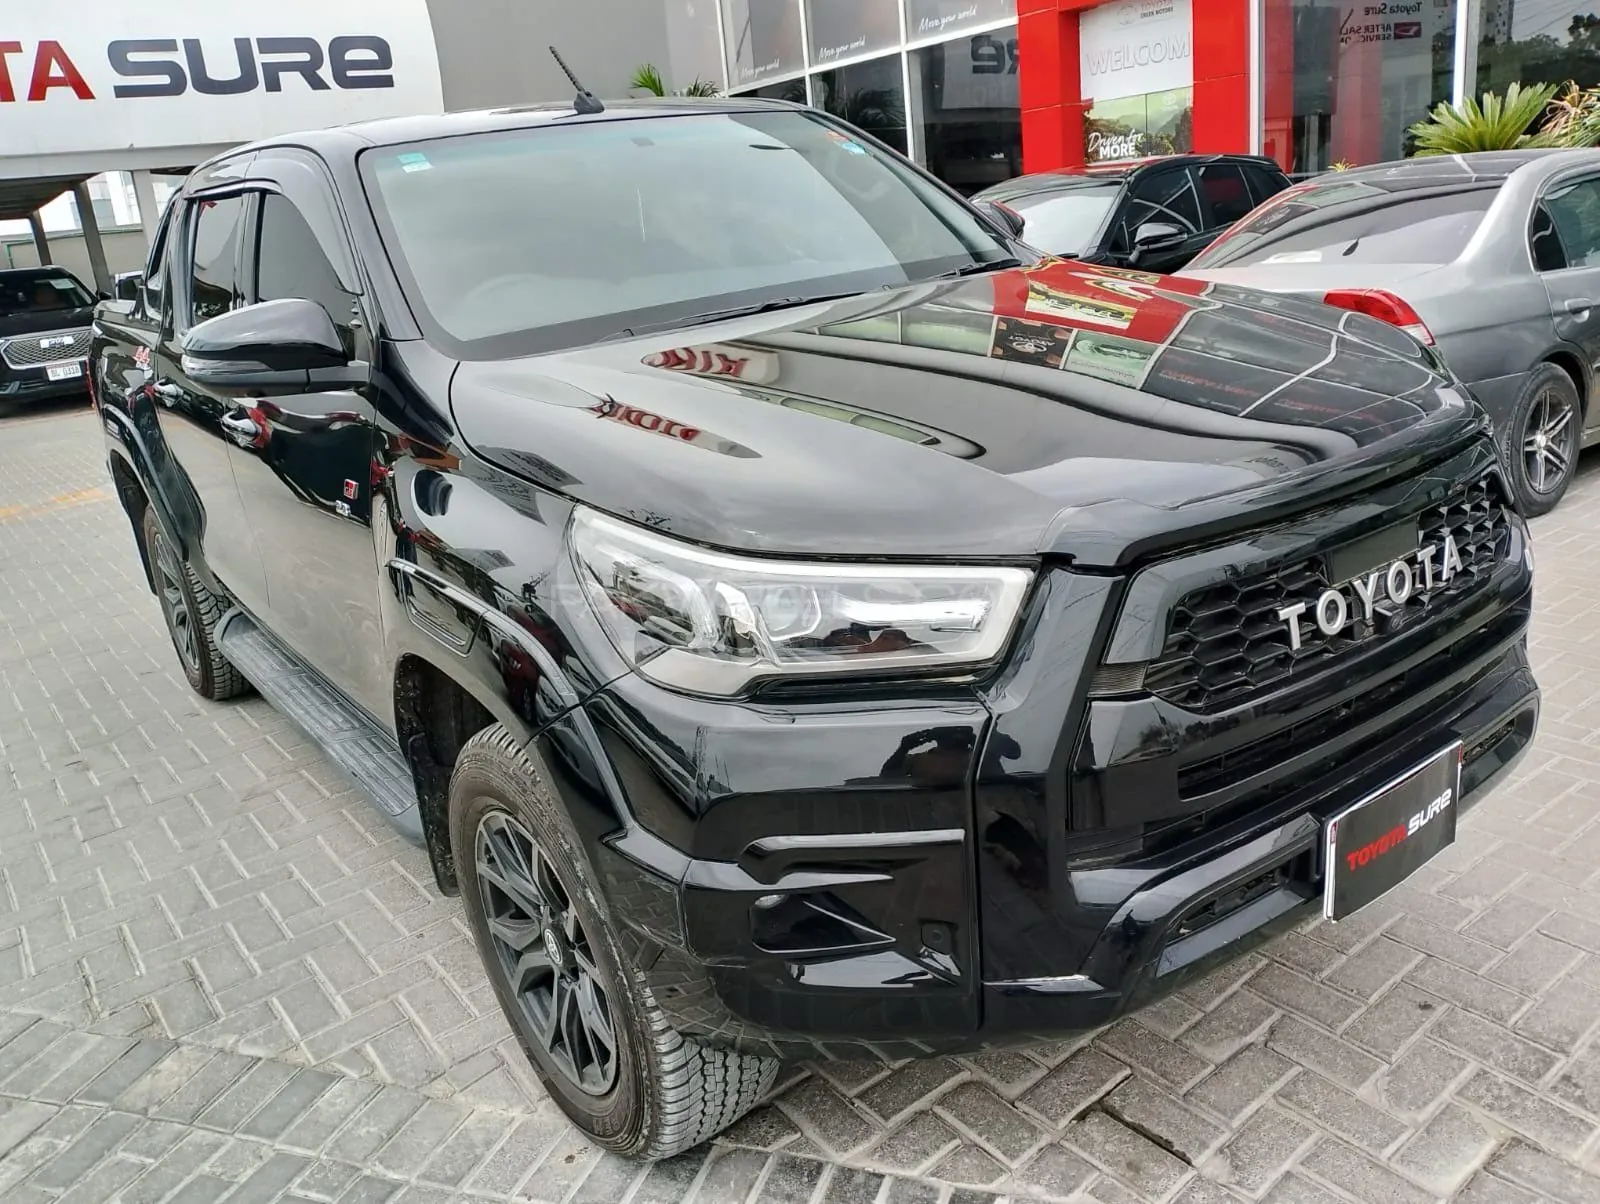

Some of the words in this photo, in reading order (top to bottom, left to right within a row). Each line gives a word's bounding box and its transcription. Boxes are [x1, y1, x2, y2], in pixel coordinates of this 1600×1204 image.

[1088, 132, 1125, 152] Driven
[1100, 142, 1136, 159] MORE
[1278, 534, 1463, 651] TOYOTA
[1346, 822, 1408, 872] TOYOTA
